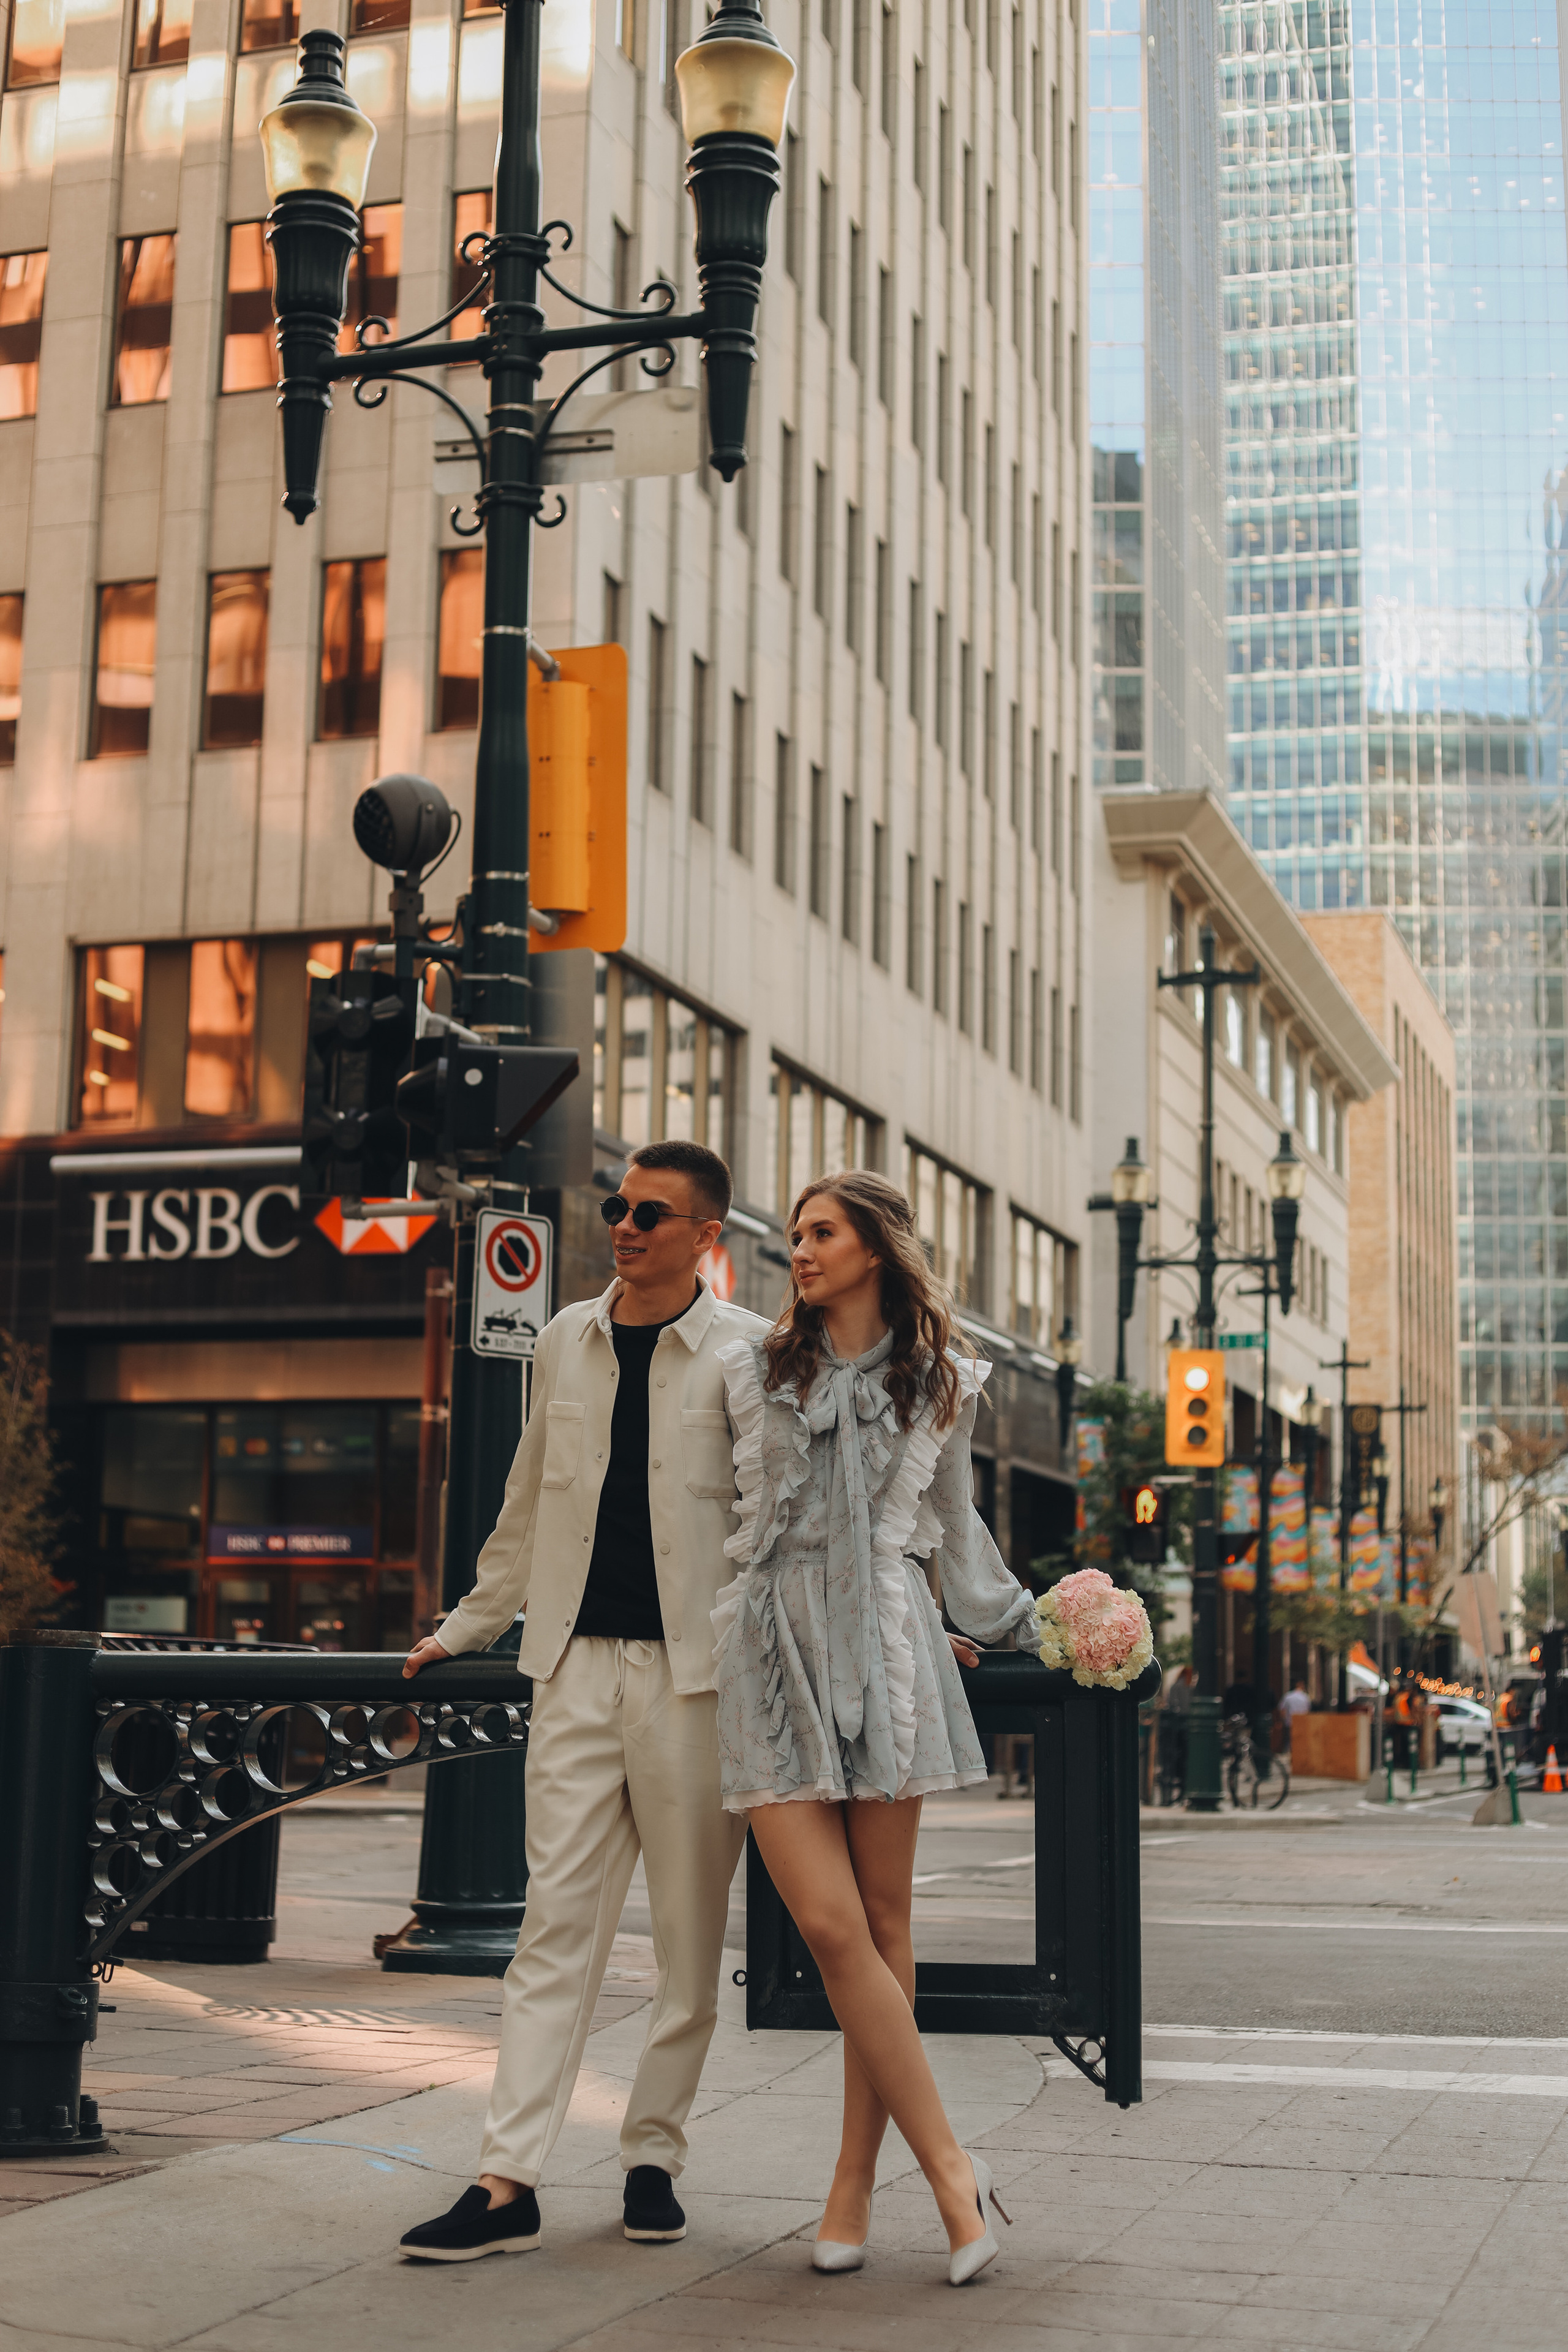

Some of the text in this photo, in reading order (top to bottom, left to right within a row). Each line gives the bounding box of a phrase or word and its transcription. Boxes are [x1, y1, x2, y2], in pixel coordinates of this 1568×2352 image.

[86, 1185, 300, 1262] HSBC
[227, 1534, 352, 1553] HSBC PREMIER
